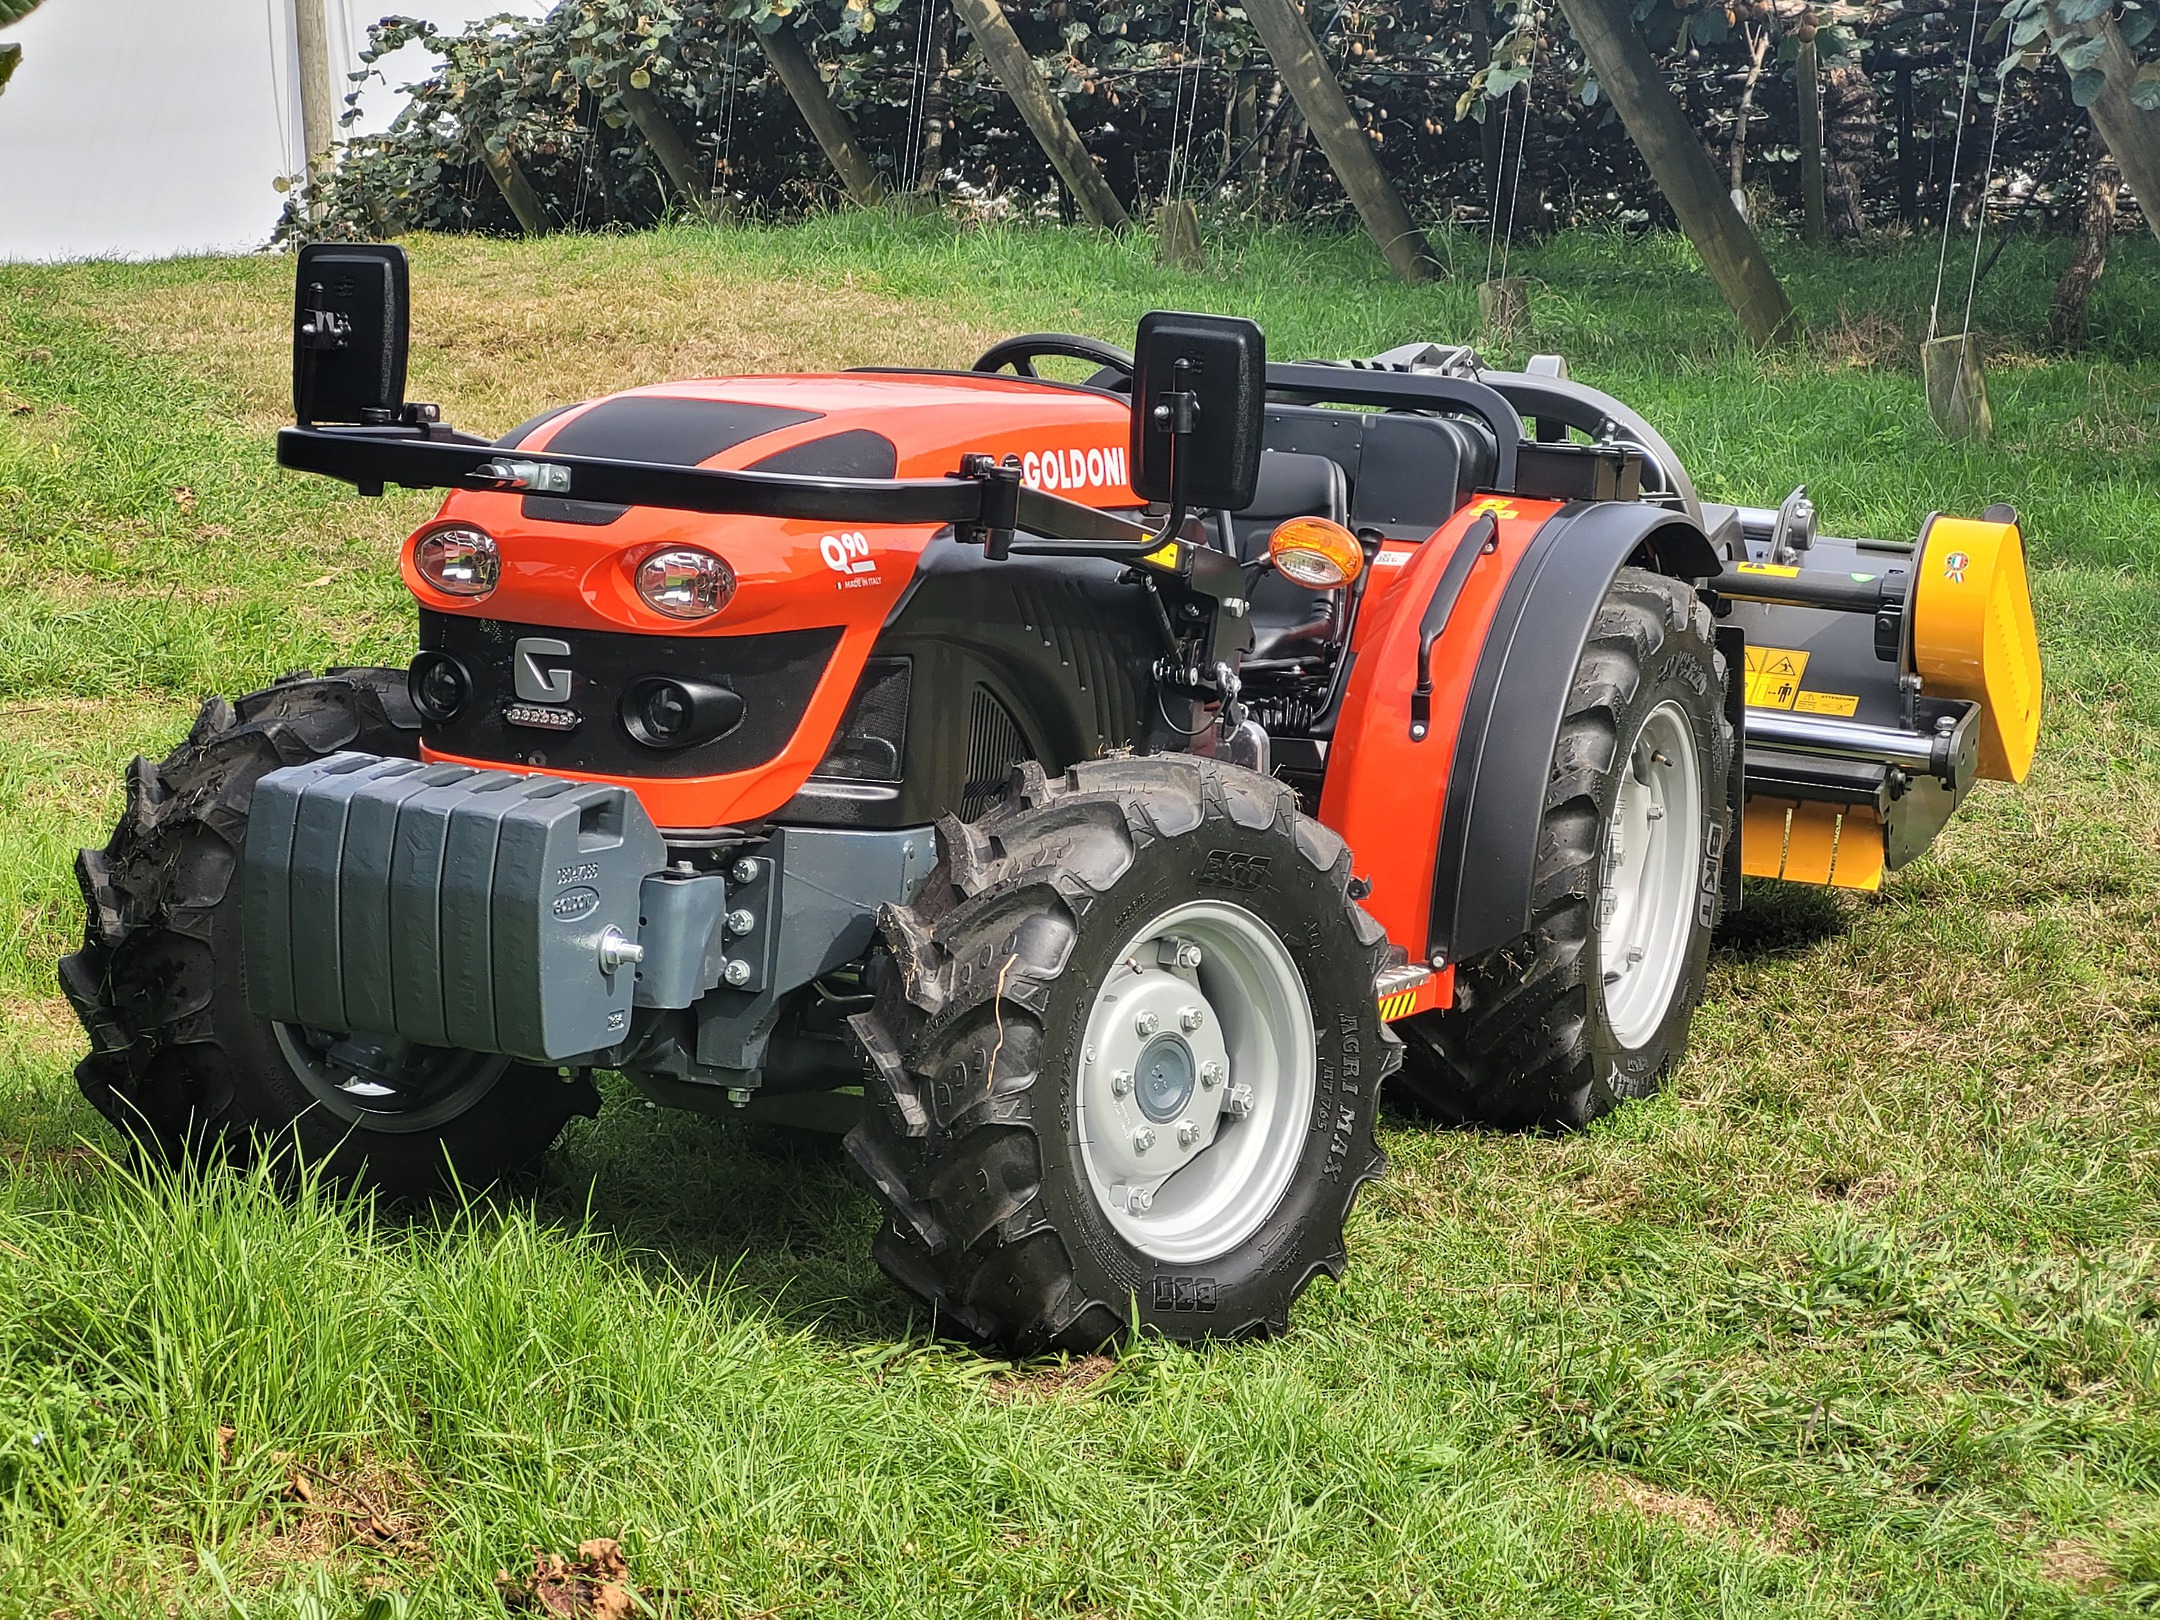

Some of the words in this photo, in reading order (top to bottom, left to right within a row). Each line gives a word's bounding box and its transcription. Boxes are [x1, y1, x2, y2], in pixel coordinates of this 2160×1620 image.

[1023, 447, 1127, 490] GOLDONI
[820, 531, 869, 575] Q90
[844, 578, 862, 589] MADE
[862, 578, 868, 587] IN
[868, 576, 882, 586] ITALY
[1699, 822, 1723, 929] BKT
[1339, 1014, 1360, 1095] AGRI
[1317, 1095, 1332, 1132] 765
[1323, 1102, 1356, 1183] MAX
